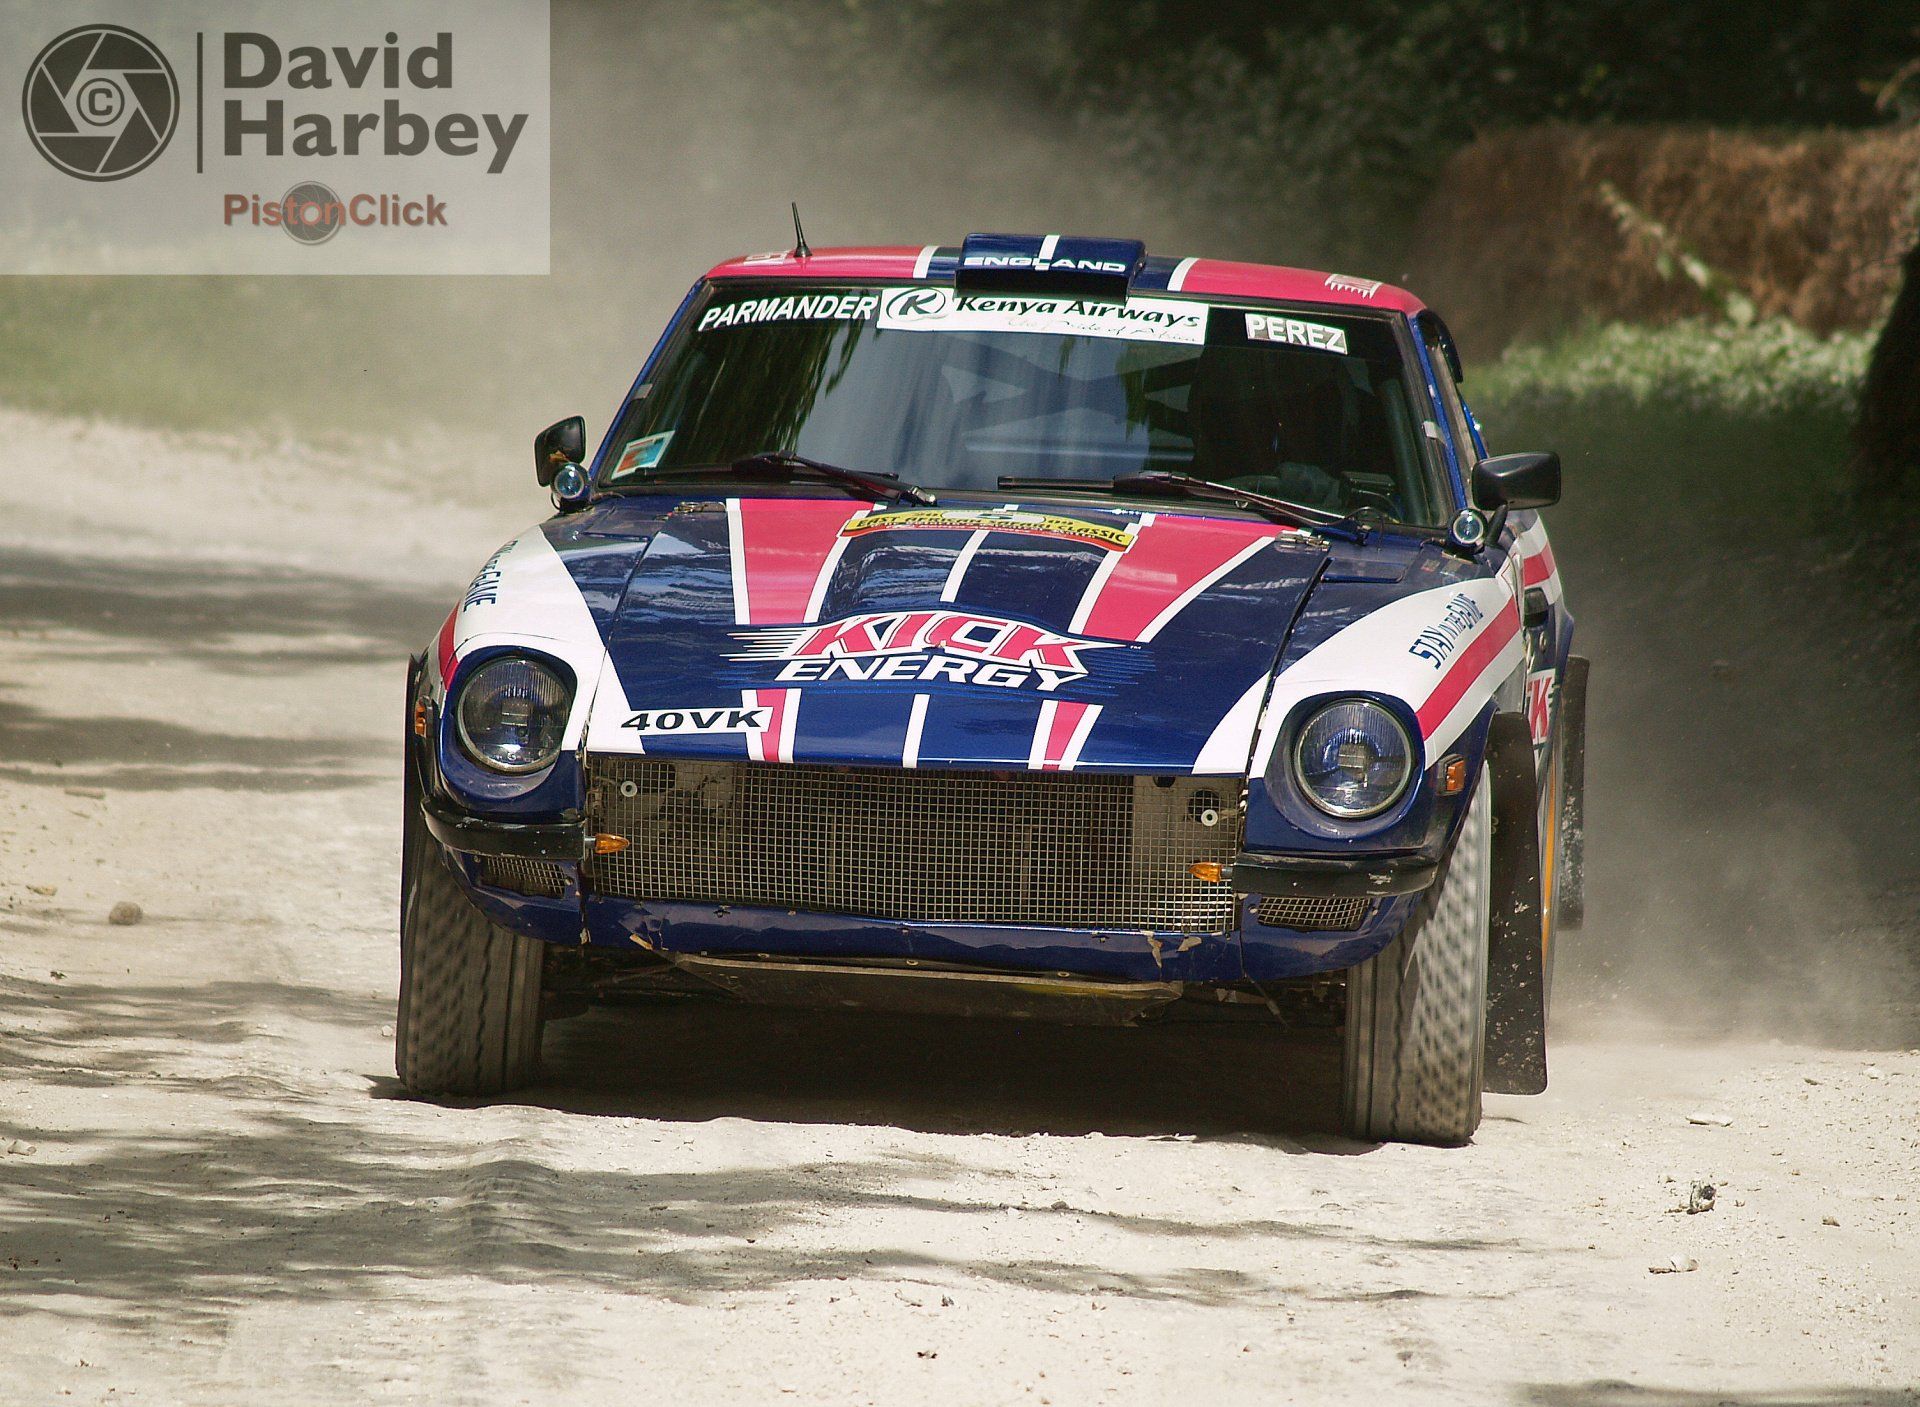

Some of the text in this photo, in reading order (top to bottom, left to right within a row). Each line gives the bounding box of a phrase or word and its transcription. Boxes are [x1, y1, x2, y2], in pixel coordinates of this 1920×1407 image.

[963, 257, 1126, 272] ENGLAND
[698, 295, 879, 333] PARMANDER
[956, 296, 1200, 328] Kenya Airways
[1247, 315, 1346, 354] PEREZ
[857, 516, 900, 528] EAST
[1058, 525, 1127, 542] CLASSIC
[783, 611, 1090, 673] KICK
[1409, 626, 1454, 669] STAY
[775, 656, 1089, 691] ENERGY
[621, 709, 764, 731] 40VK
